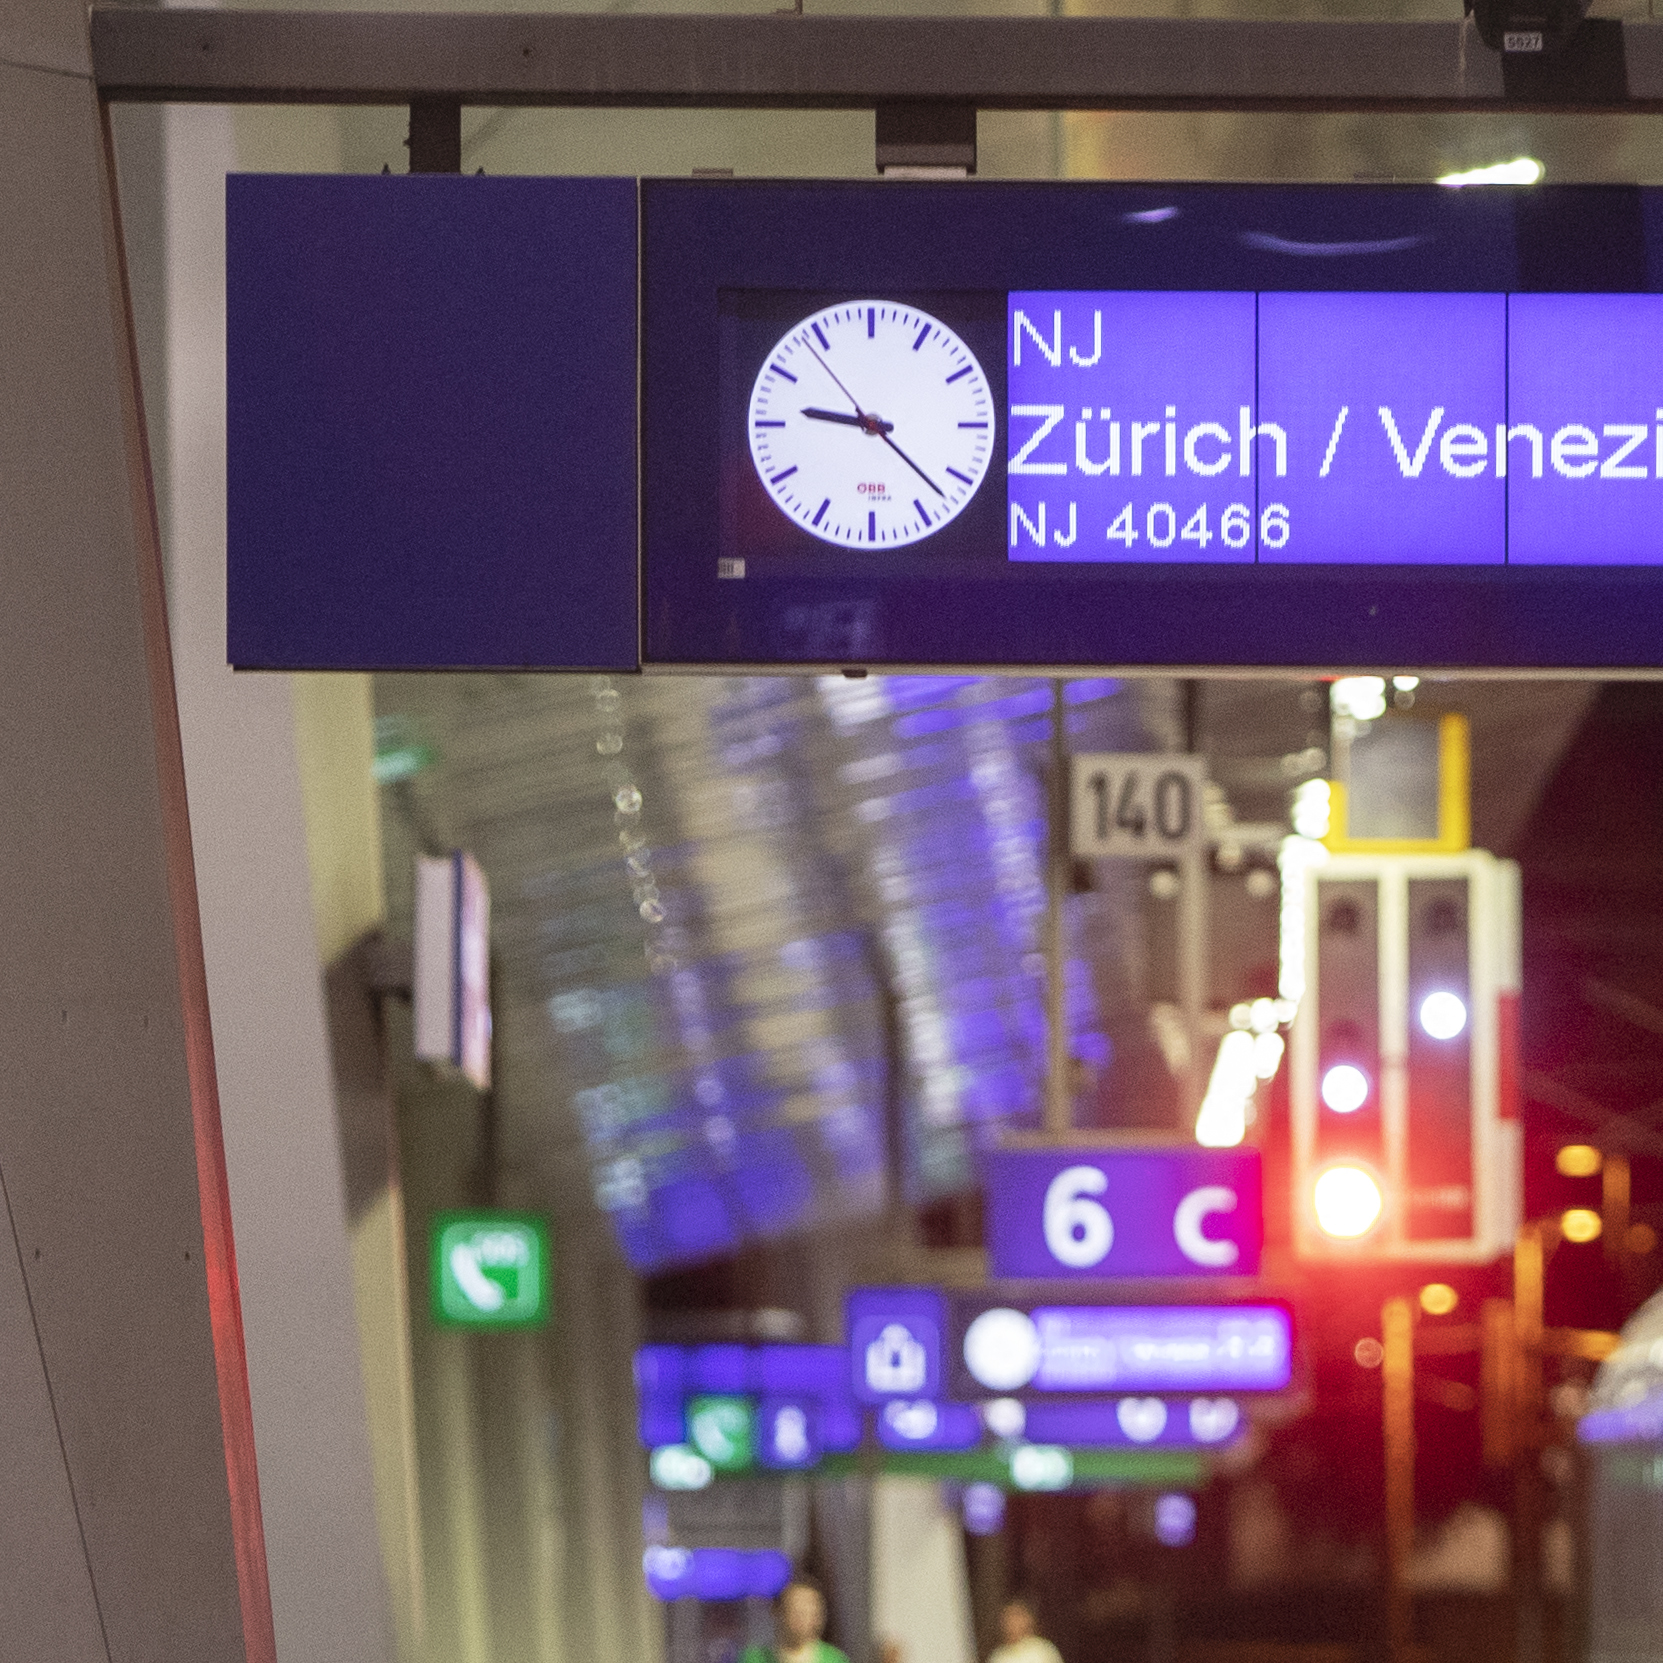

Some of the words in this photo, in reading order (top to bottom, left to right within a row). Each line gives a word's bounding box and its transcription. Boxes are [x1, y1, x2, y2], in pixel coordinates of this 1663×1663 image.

[1013, 309, 1102, 367] NJ
[1007, 404, 1288, 477] Zürich
[1318, 405, 1349, 478] /
[1010, 501, 1077, 548] NJ
[1106, 502, 1291, 549] 40466
[1087, 769, 1192, 840] 140
[1042, 1164, 1115, 1269] 6
